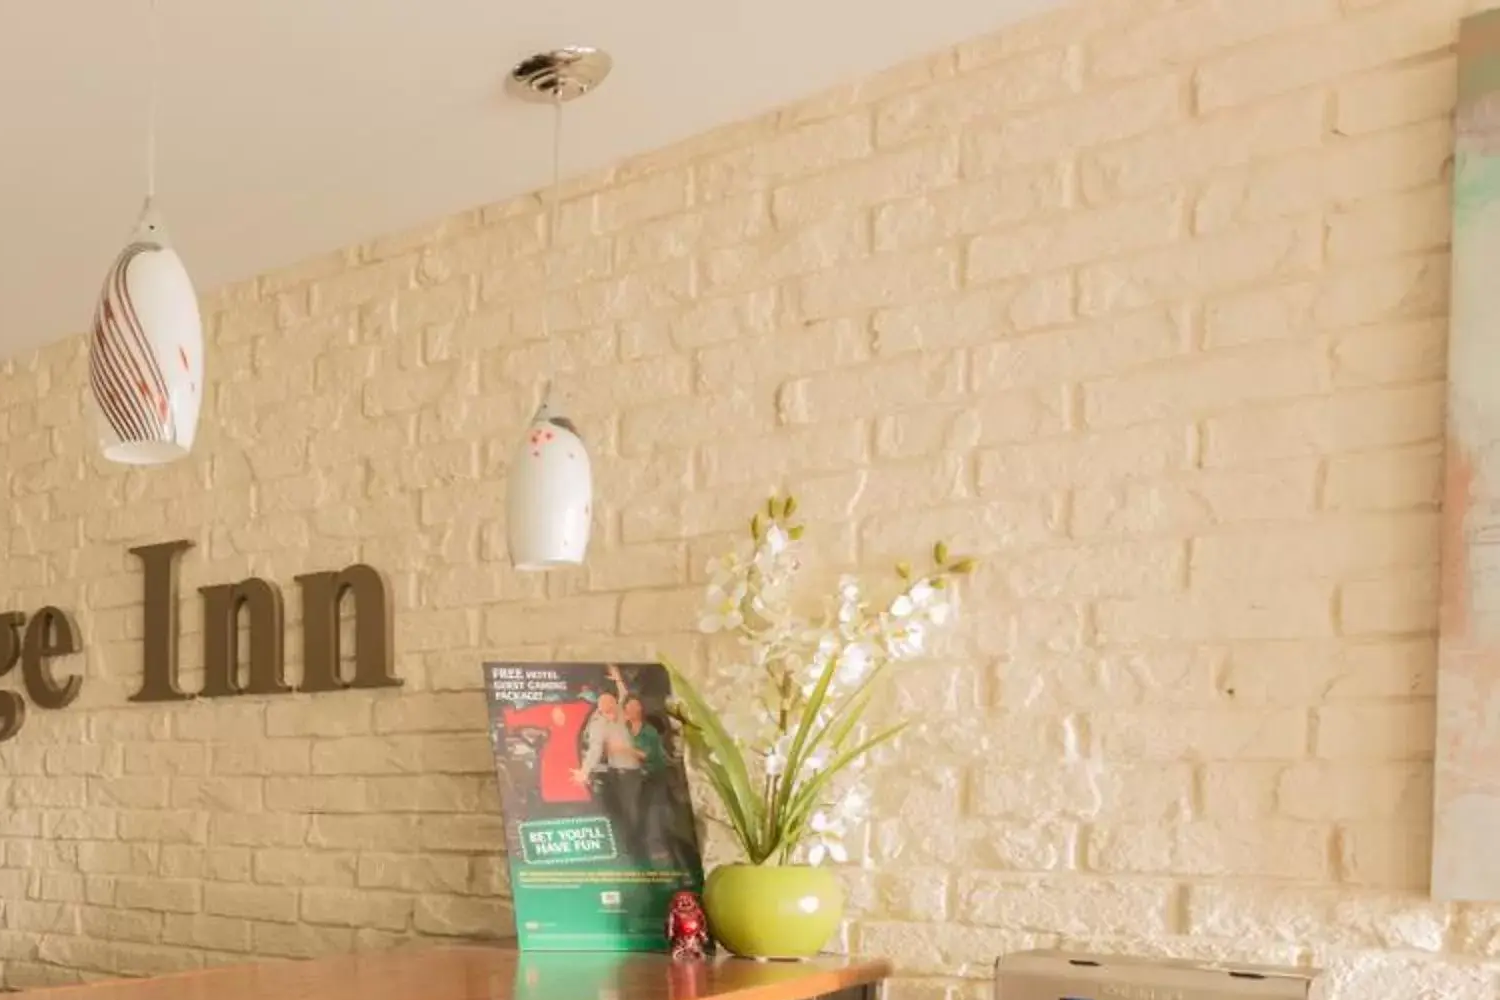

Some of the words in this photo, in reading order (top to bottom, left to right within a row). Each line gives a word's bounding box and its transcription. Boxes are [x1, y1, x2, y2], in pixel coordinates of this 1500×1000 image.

[128, 540, 403, 702] Inn
[492, 667, 524, 680] FREE
[574, 839, 601, 851] FUN
